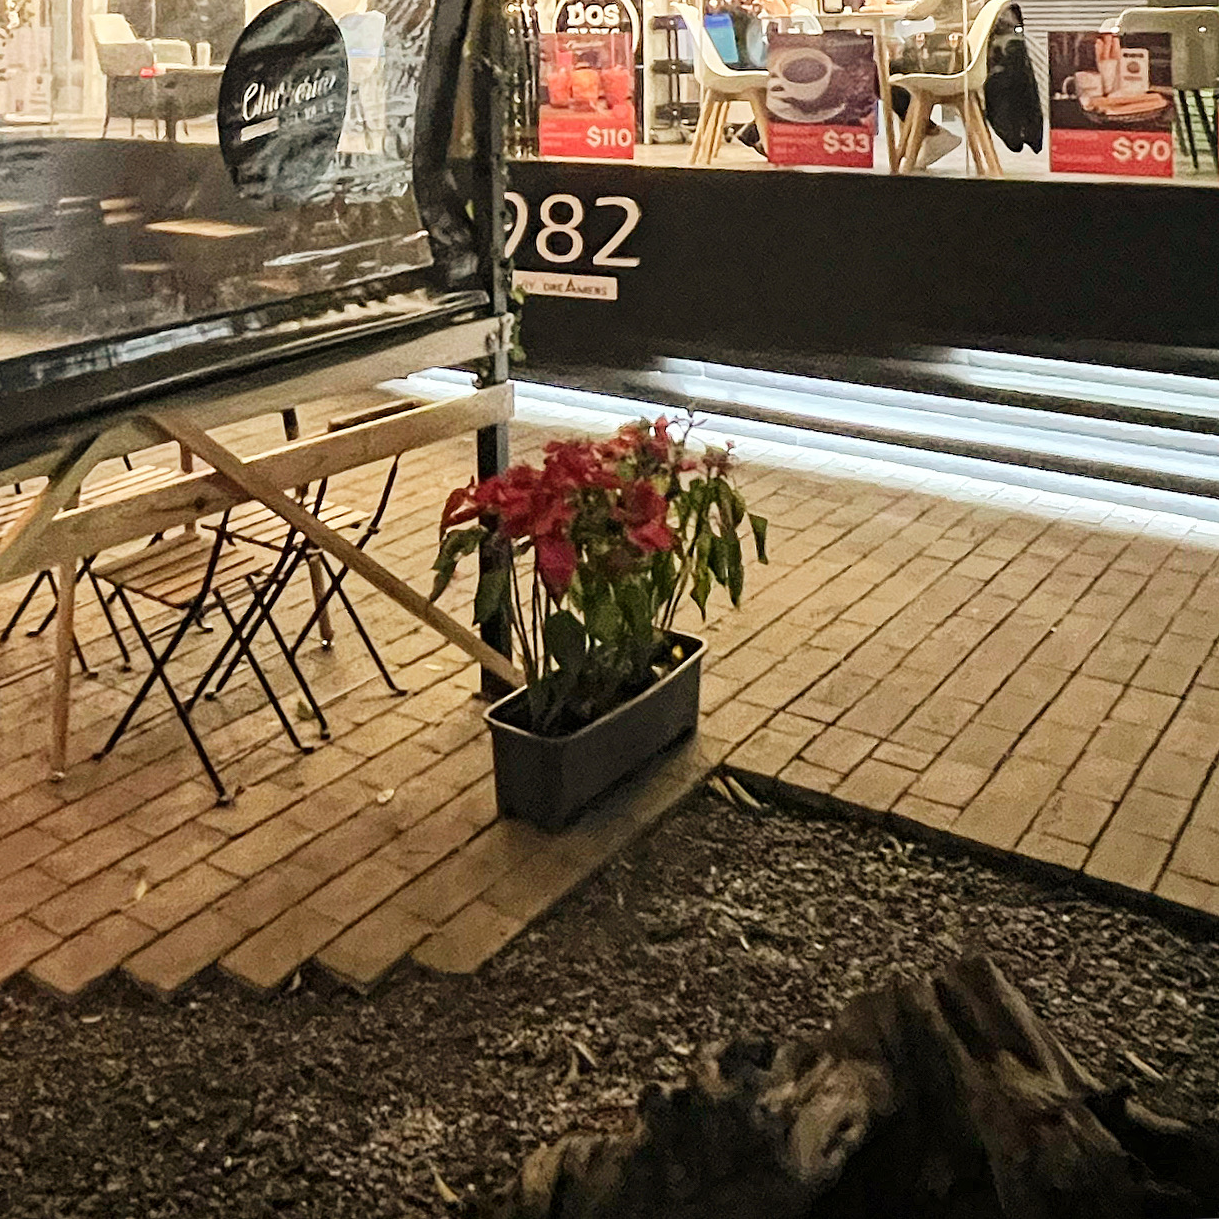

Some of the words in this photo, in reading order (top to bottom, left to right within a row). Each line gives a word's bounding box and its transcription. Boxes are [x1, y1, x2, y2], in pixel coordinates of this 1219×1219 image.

[566, 1, 620, 27] DOS
[586, 125, 632, 148] $110
[823, 129, 871, 155] $33
[1112, 136, 1171, 162] $90
